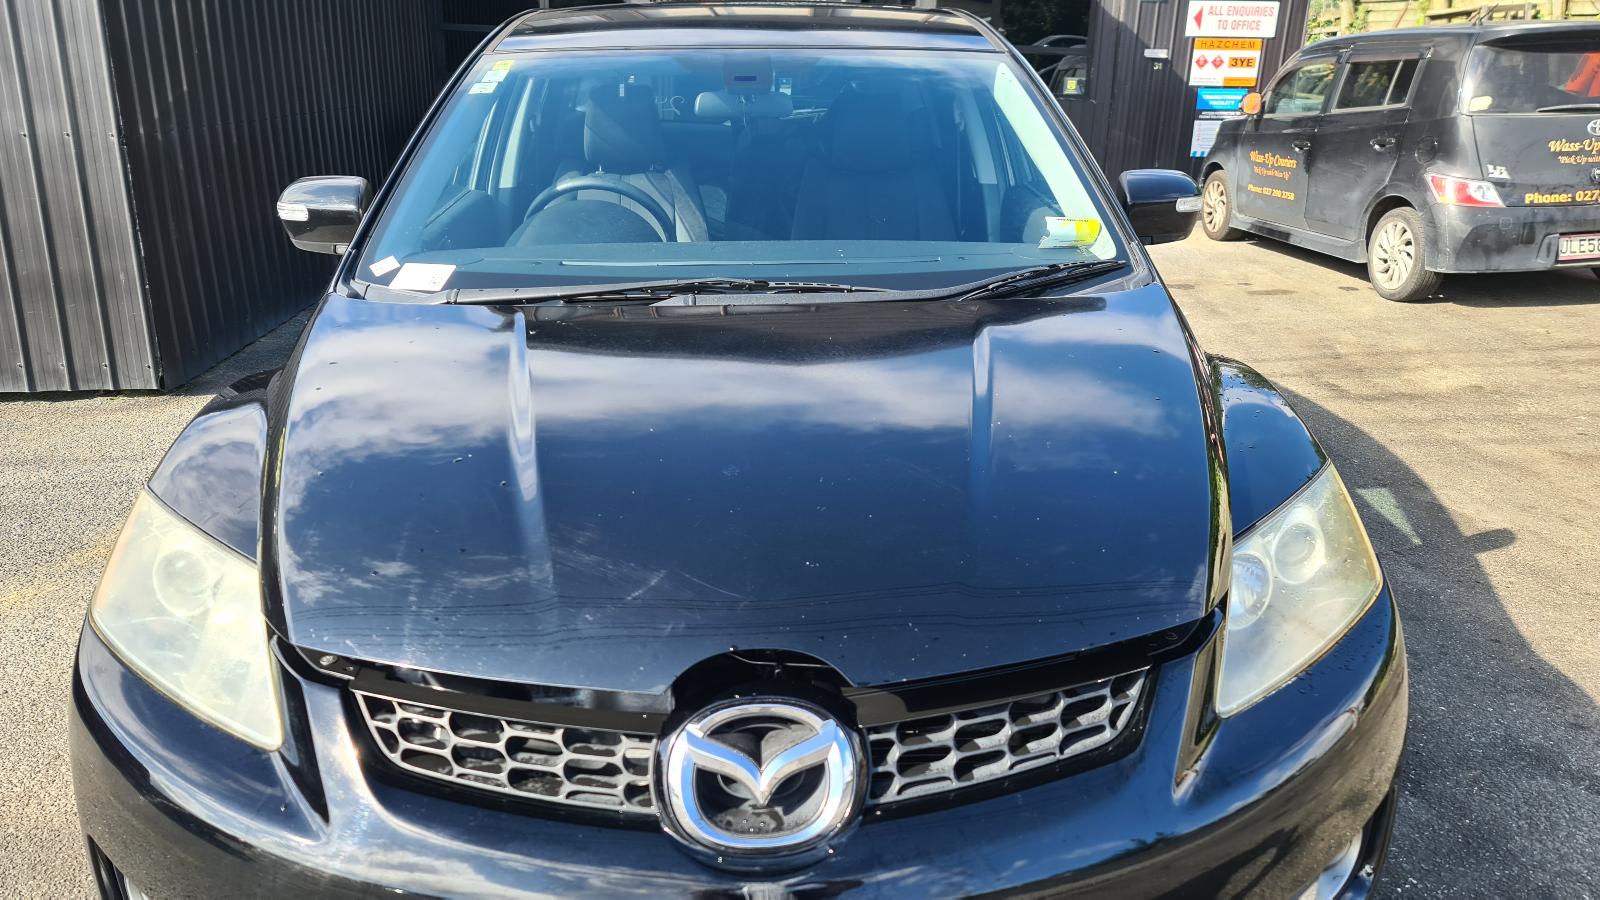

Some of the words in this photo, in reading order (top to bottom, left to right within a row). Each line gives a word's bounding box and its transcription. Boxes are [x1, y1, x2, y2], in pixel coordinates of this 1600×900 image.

[1208, 6, 1224, 16] ALL
[1227, 6, 1275, 17] ENQUIRIES
[1217, 20, 1229, 30] TO
[1231, 20, 1262, 31] OFFICE
[1200, 40, 1256, 49] HAZCHEM
[1231, 58, 1254, 67] 3YE
[1524, 192, 1572, 204] Phone:
[1575, 190, 1600, 202] 027
